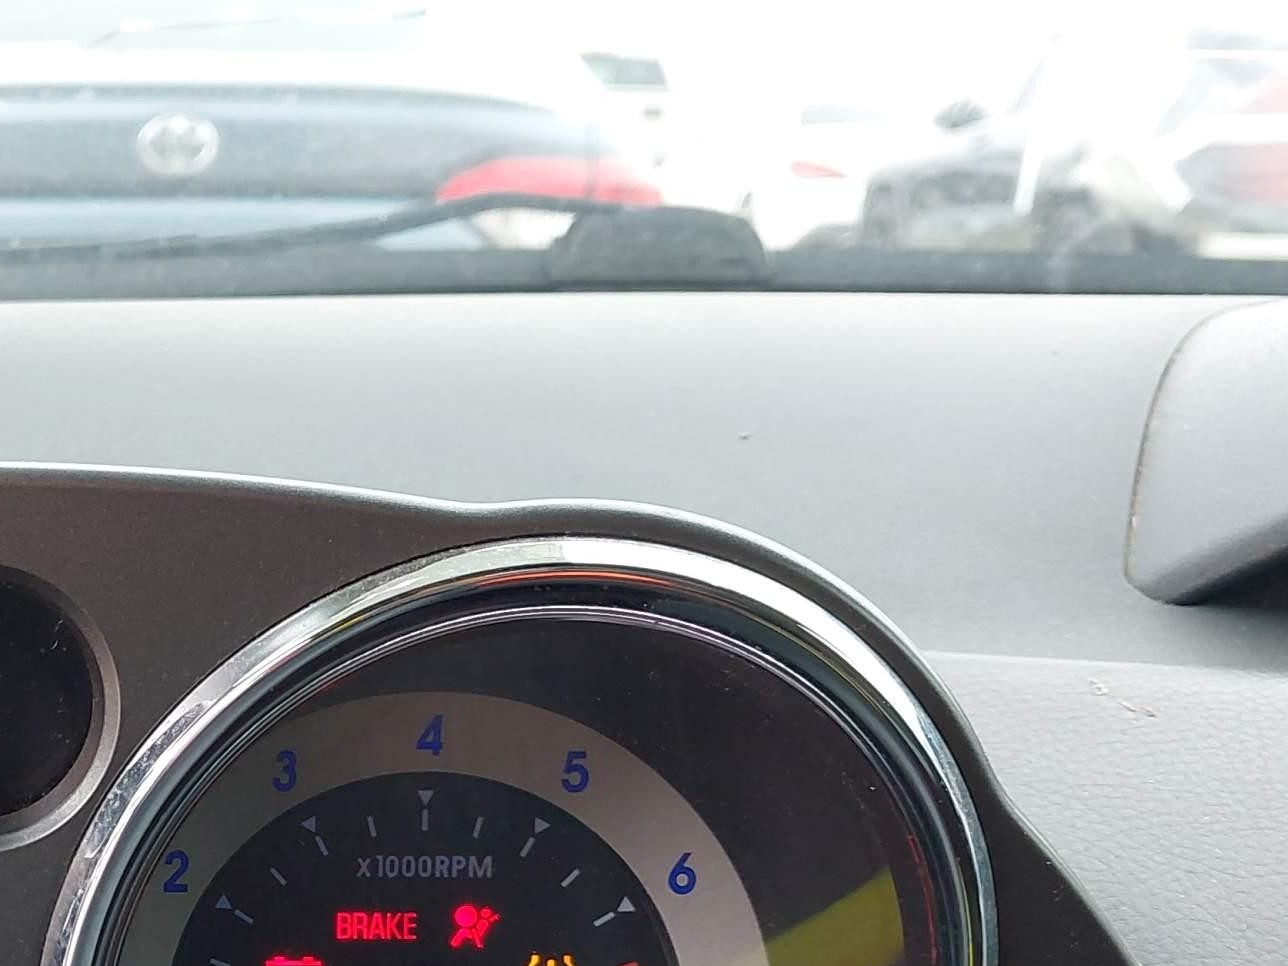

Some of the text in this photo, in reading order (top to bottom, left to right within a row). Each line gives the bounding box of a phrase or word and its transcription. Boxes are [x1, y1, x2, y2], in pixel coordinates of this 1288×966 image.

[417, 714, 445, 756] 4
[272, 751, 297, 792] 3
[561, 751, 591, 793] 5
[162, 851, 190, 893] 2
[667, 852, 697, 895] 6
[336, 912, 418, 940] BRAKE
